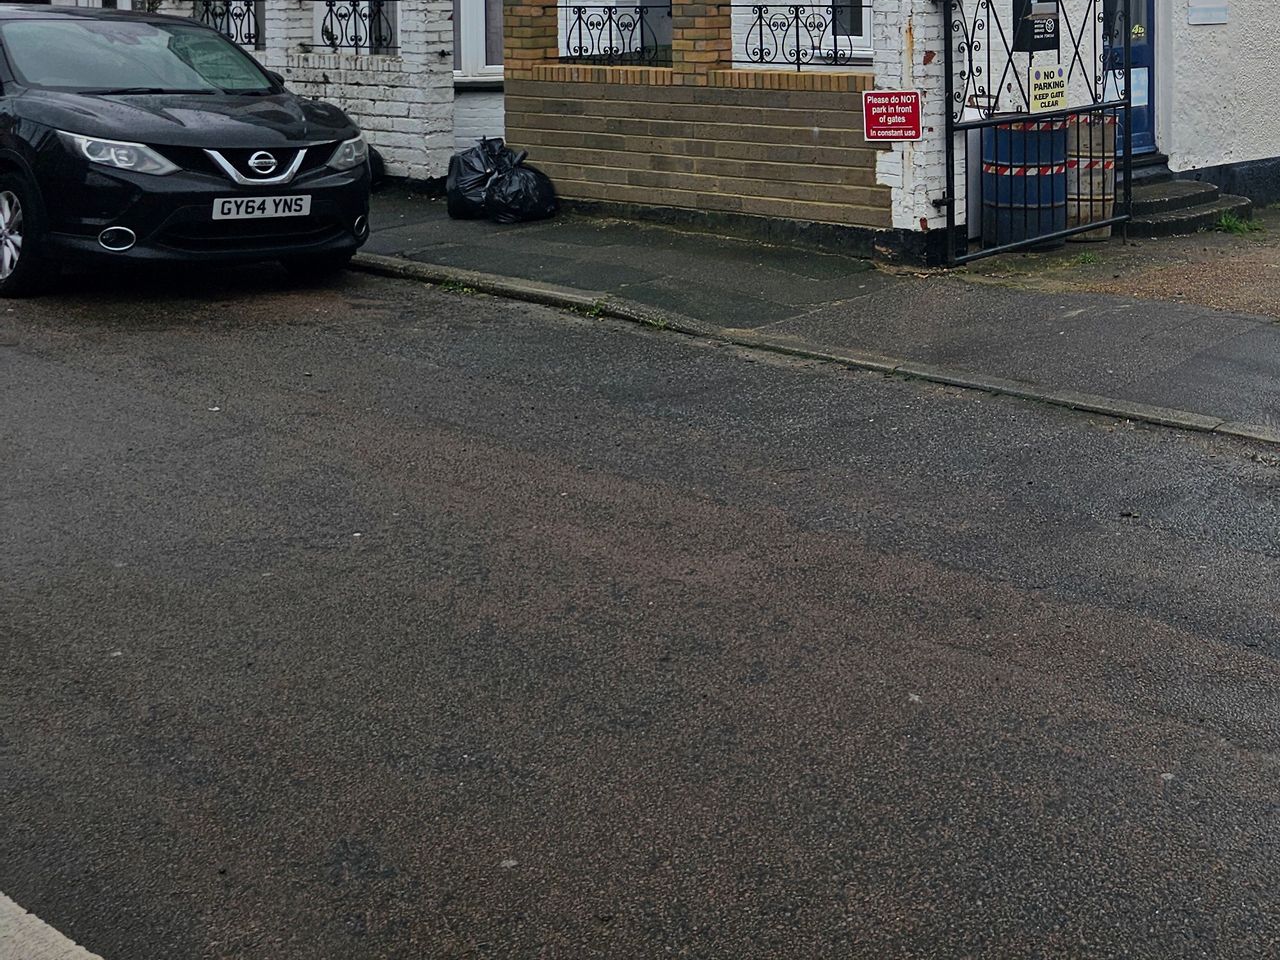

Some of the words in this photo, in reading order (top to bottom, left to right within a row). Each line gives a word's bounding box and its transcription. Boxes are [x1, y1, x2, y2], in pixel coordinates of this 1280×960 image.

[1043, 70, 1055, 80] NO
[1034, 80, 1064, 91] PARKING
[867, 95, 889, 104] Please
[890, 95, 899, 103] do
[900, 95, 916, 103] NOT
[1034, 92, 1049, 101] KEEP
[1050, 91, 1064, 99] GATE
[1040, 100, 1059, 108] CLEAR
[872, 105, 887, 115] park
[888, 105, 894, 113] in
[896, 105, 912, 113] front
[879, 115, 886, 123] of
[887, 115, 906, 125] gates
[220, 199, 267, 216] GY64
[272, 197, 304, 213] YNS
